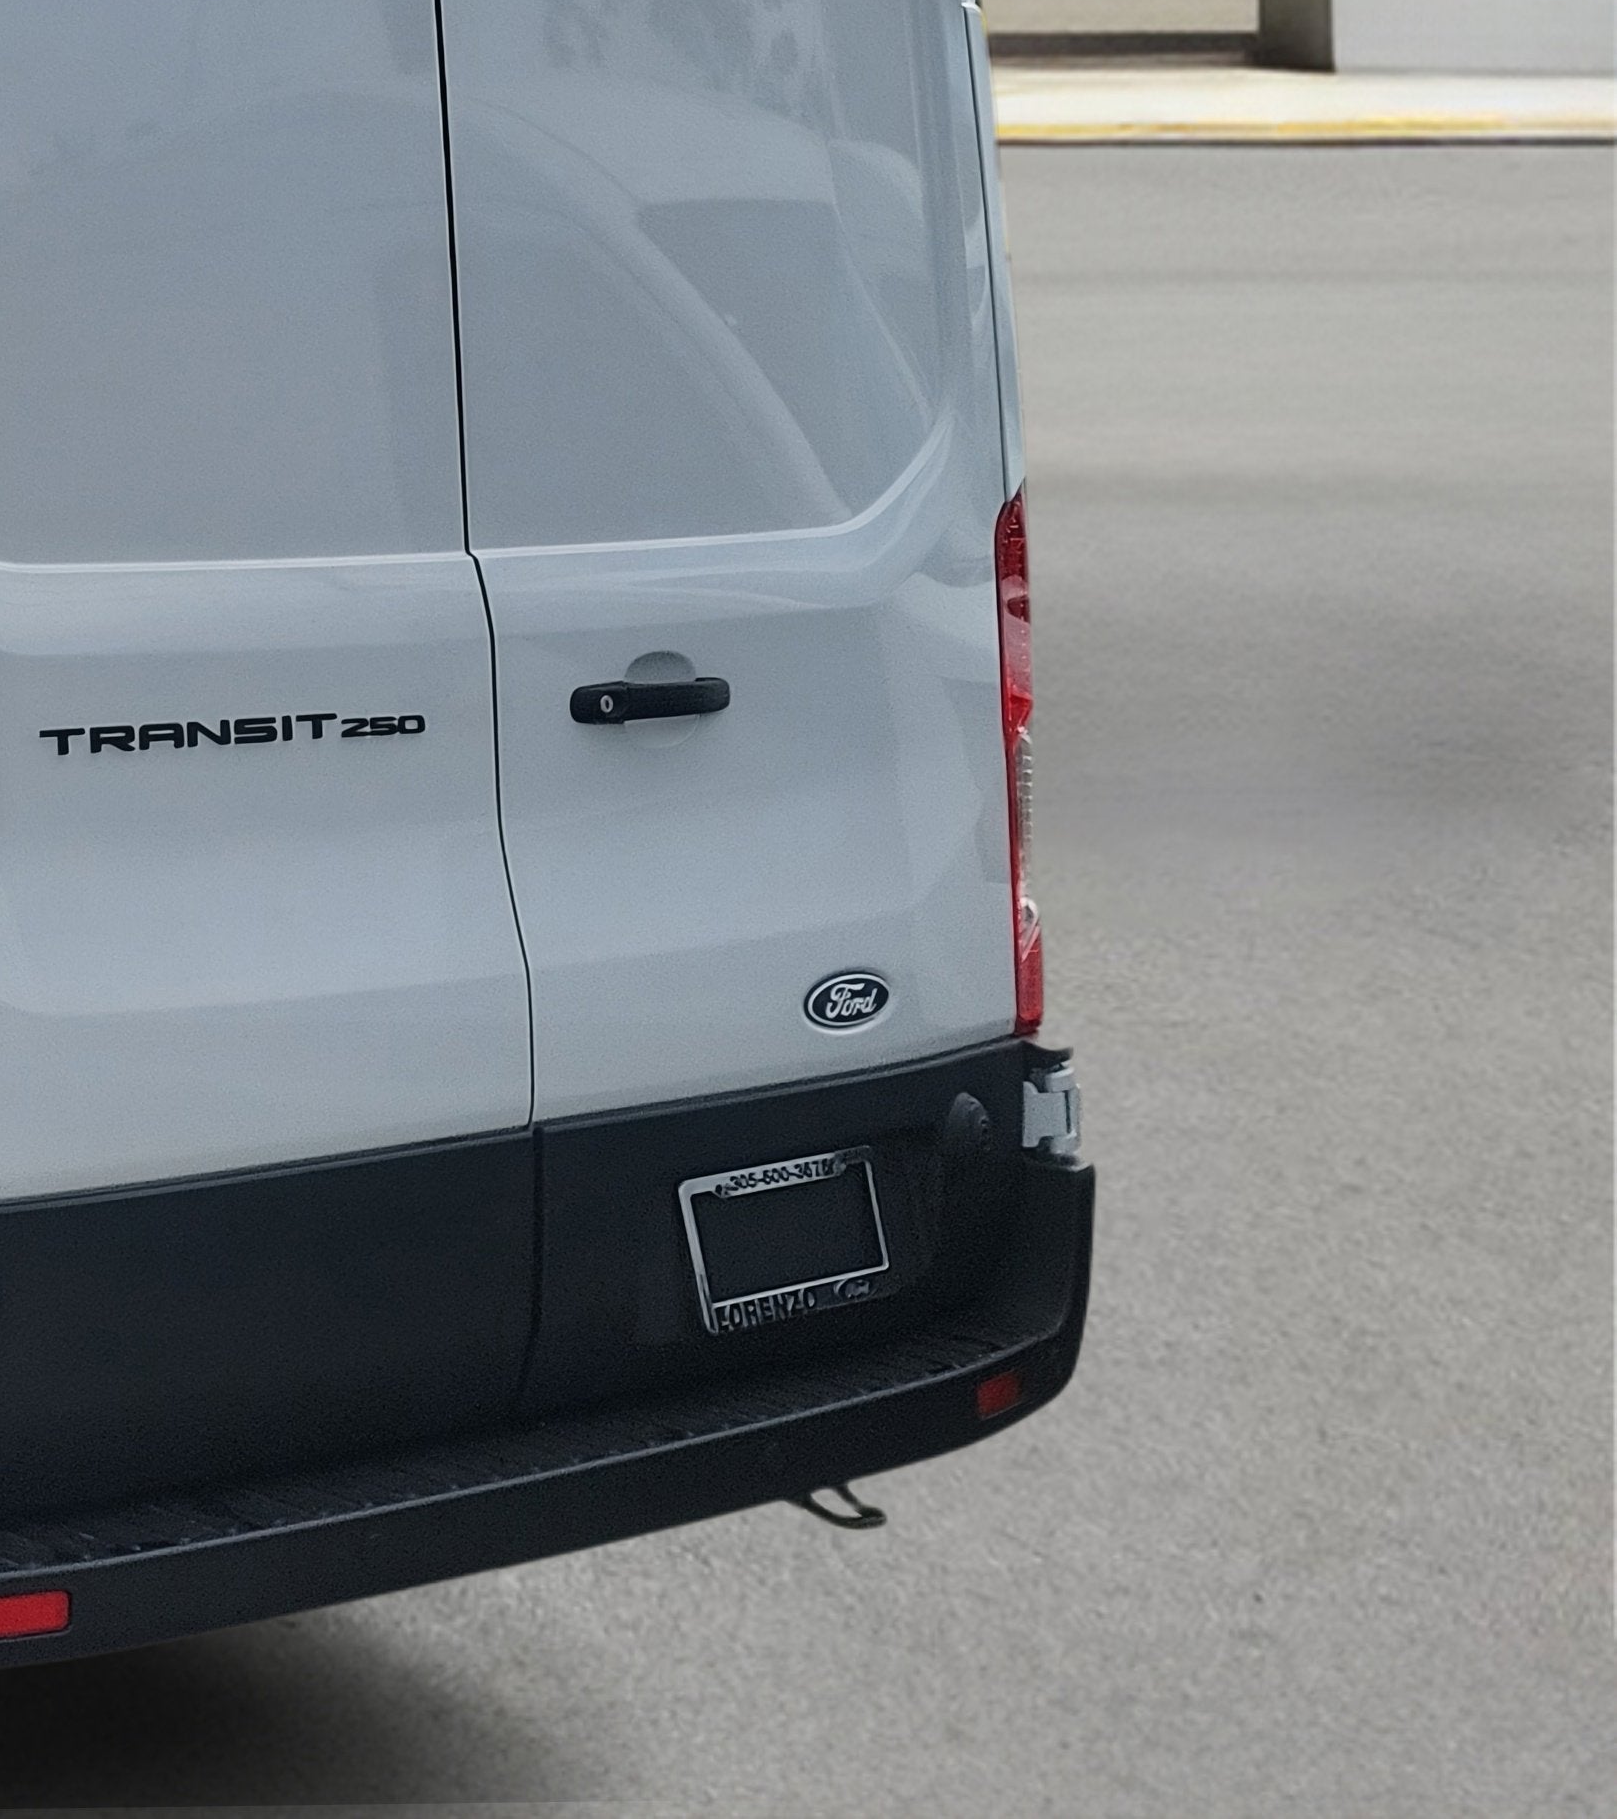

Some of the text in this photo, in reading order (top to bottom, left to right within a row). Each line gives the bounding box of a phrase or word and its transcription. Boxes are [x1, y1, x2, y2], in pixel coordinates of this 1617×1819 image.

[39, 713, 427, 756] TRANSIT 250
[825, 982, 878, 1019] Ford
